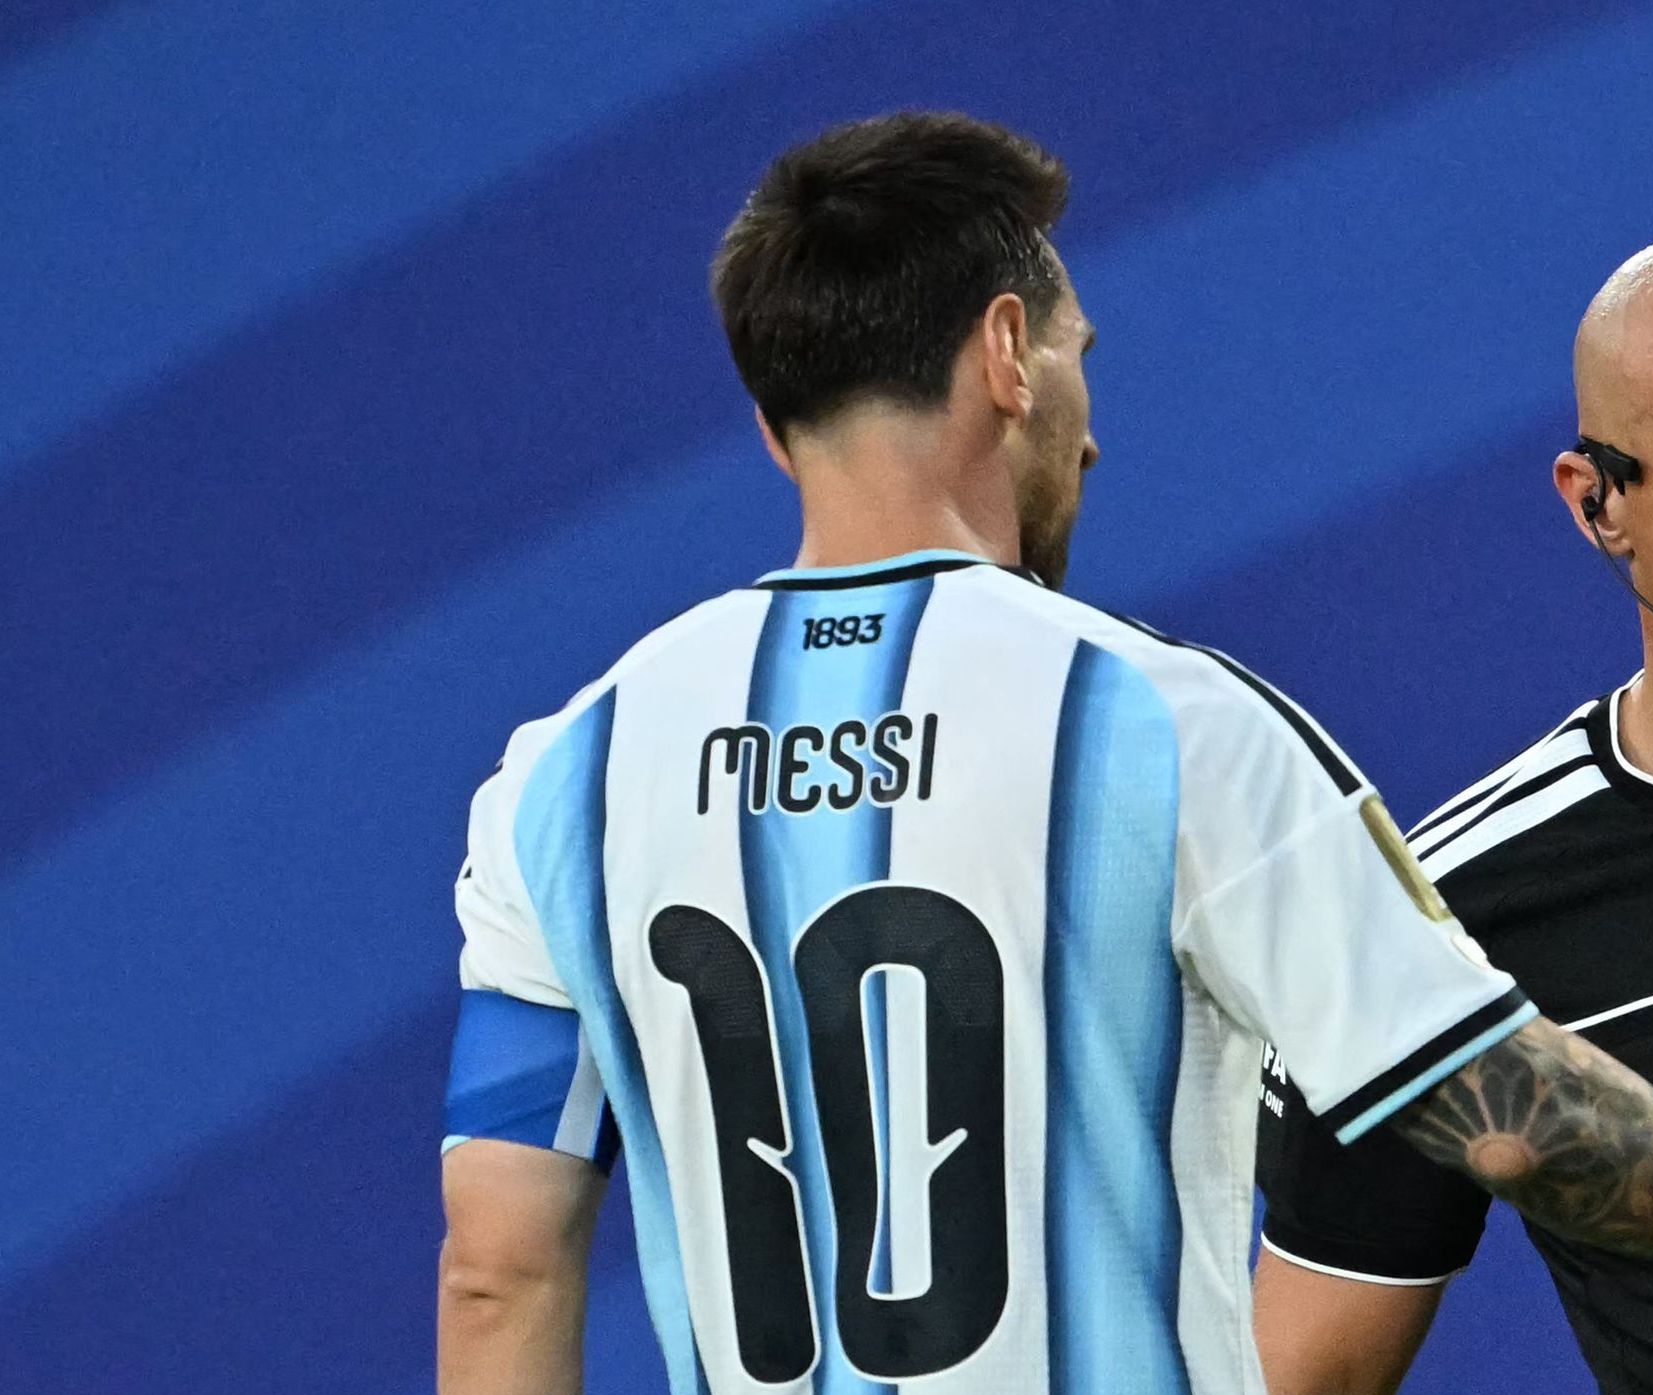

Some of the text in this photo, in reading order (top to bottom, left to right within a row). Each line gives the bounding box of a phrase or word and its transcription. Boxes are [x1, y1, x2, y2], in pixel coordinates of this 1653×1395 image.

[803, 613, 886, 651] 1893
[696, 712, 939, 816] MESSI
[648, 882, 1009, 1384] 10
[1265, 1090, 1284, 1118] ONE
